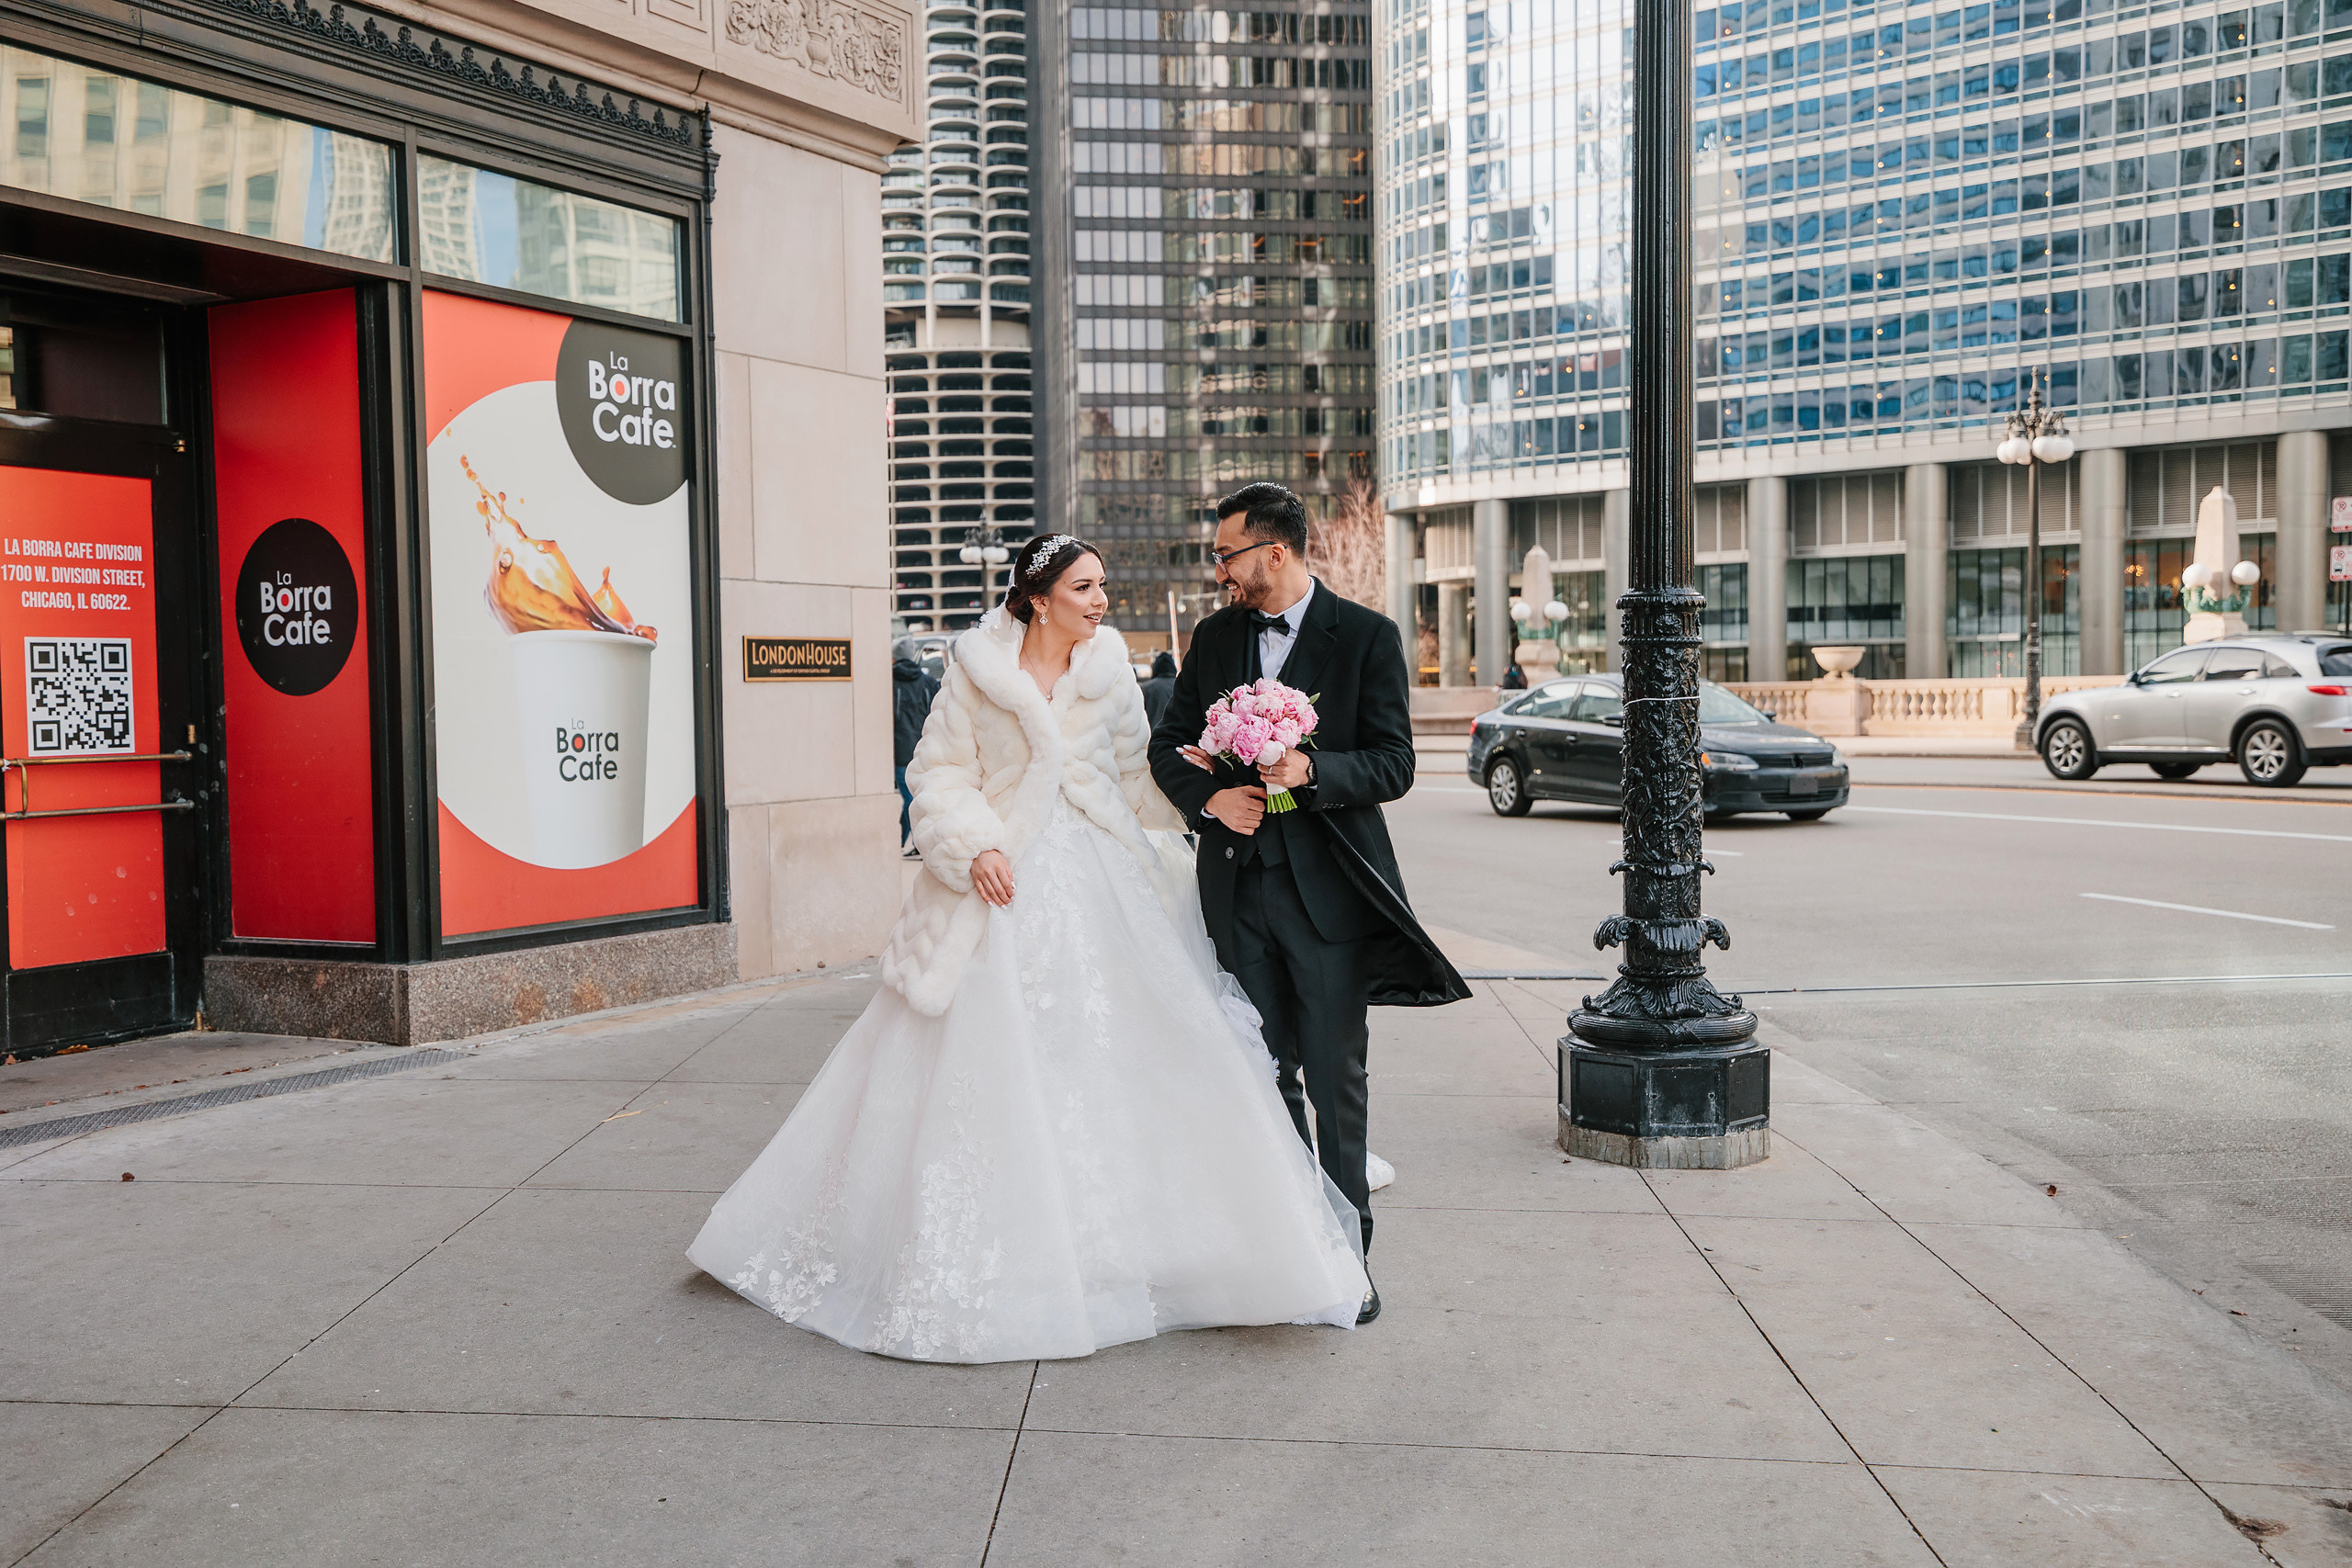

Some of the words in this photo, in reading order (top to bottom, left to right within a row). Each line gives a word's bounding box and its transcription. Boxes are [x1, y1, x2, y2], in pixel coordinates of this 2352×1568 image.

[609, 350, 628, 371] La
[588, 359, 676, 412] Borra
[4, 537, 20, 556] LA
[22, 539, 62, 558] BORRA
[64, 541, 94, 559] CAFE
[96, 543, 142, 562] DIVISION
[0, 564, 32, 581] 1700
[34, 565, 50, 583] W.
[51, 566, 101, 585] DIVISION
[102, 570, 146, 589] STREET,
[277, 570, 292, 586] La
[21, 591, 75, 612] CHICAGO,
[77, 592, 89, 609] IL
[90, 592, 131, 611] 60622.
[260, 581, 333, 614] Borra
[571, 717, 584, 730] La
[556, 727, 619, 753] Borra
